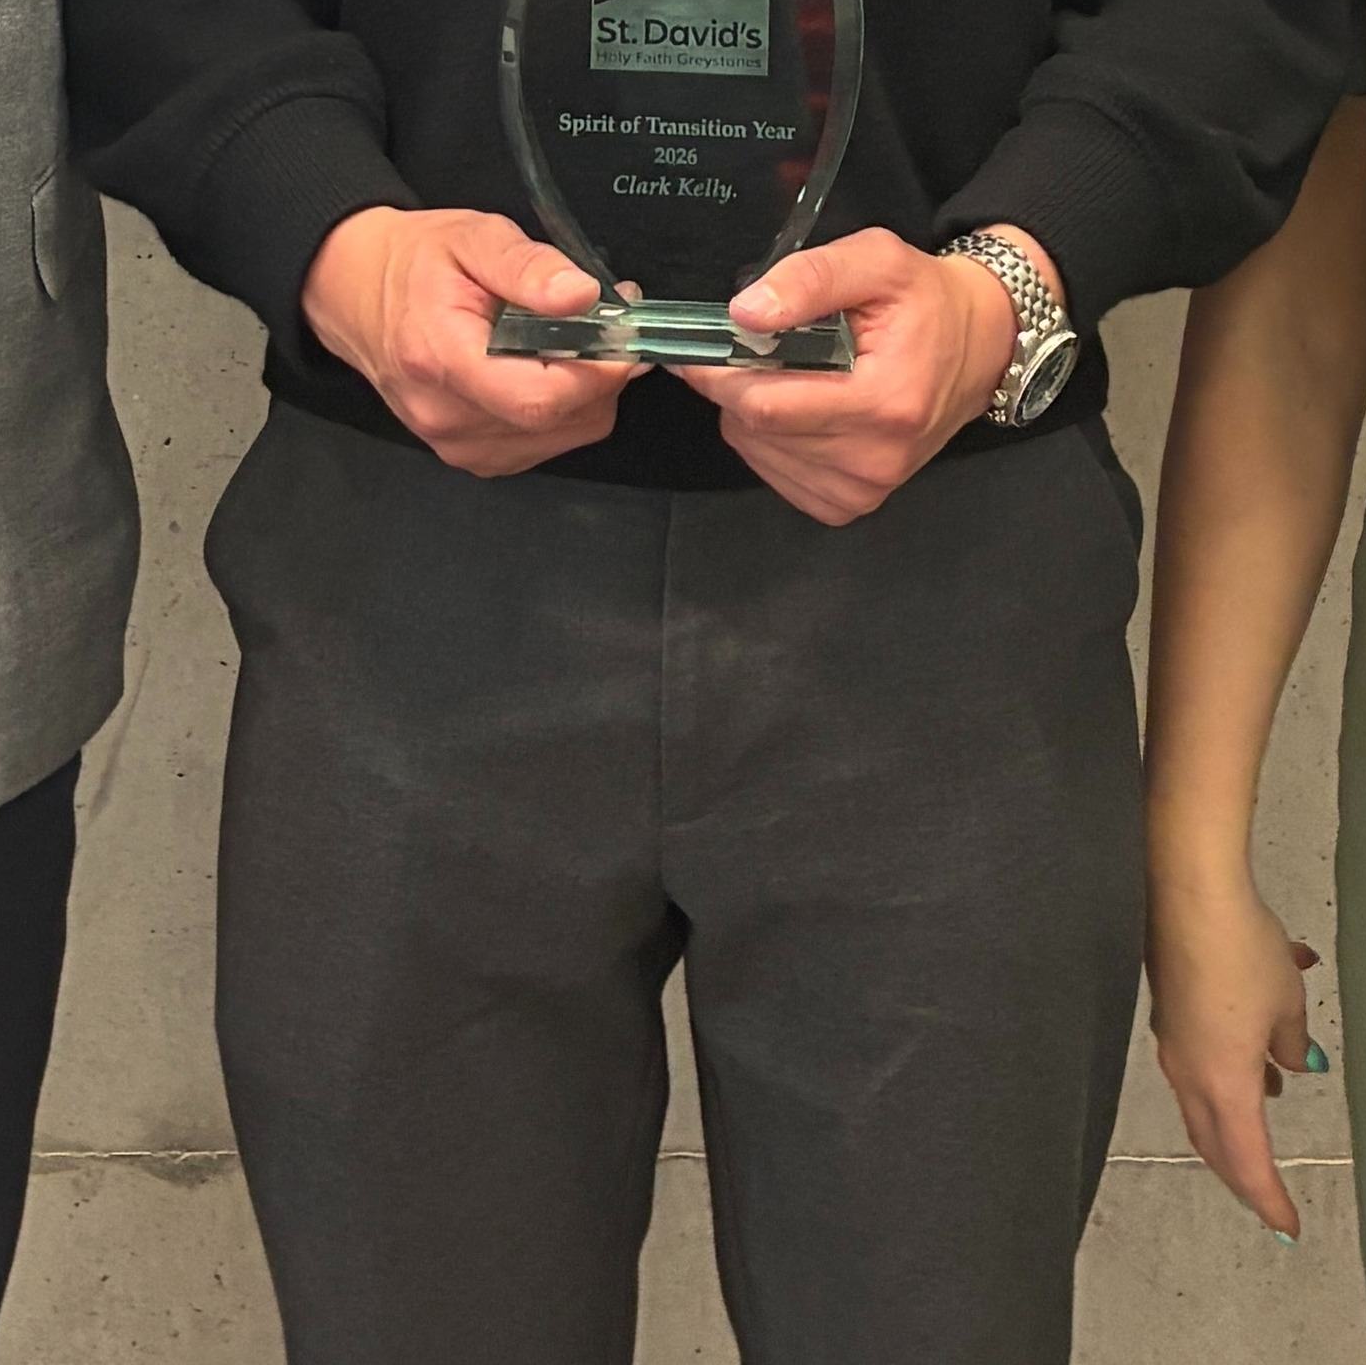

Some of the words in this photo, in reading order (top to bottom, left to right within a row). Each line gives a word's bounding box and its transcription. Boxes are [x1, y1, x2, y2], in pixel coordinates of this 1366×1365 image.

[597, 17, 638, 45] St.
[645, 19, 763, 49] David's
[597, 51, 632, 65] Holy
[636, 52, 672, 65] Faith
[677, 53, 762, 69] Greystones
[559, 113, 615, 138] Spirit
[619, 117, 641, 133] of
[646, 117, 746, 139] Transition
[753, 121, 796, 140] Year
[654, 147, 698, 165] 2026
[613, 175, 670, 196] Clark
[677, 177, 738, 204] Kelly.
